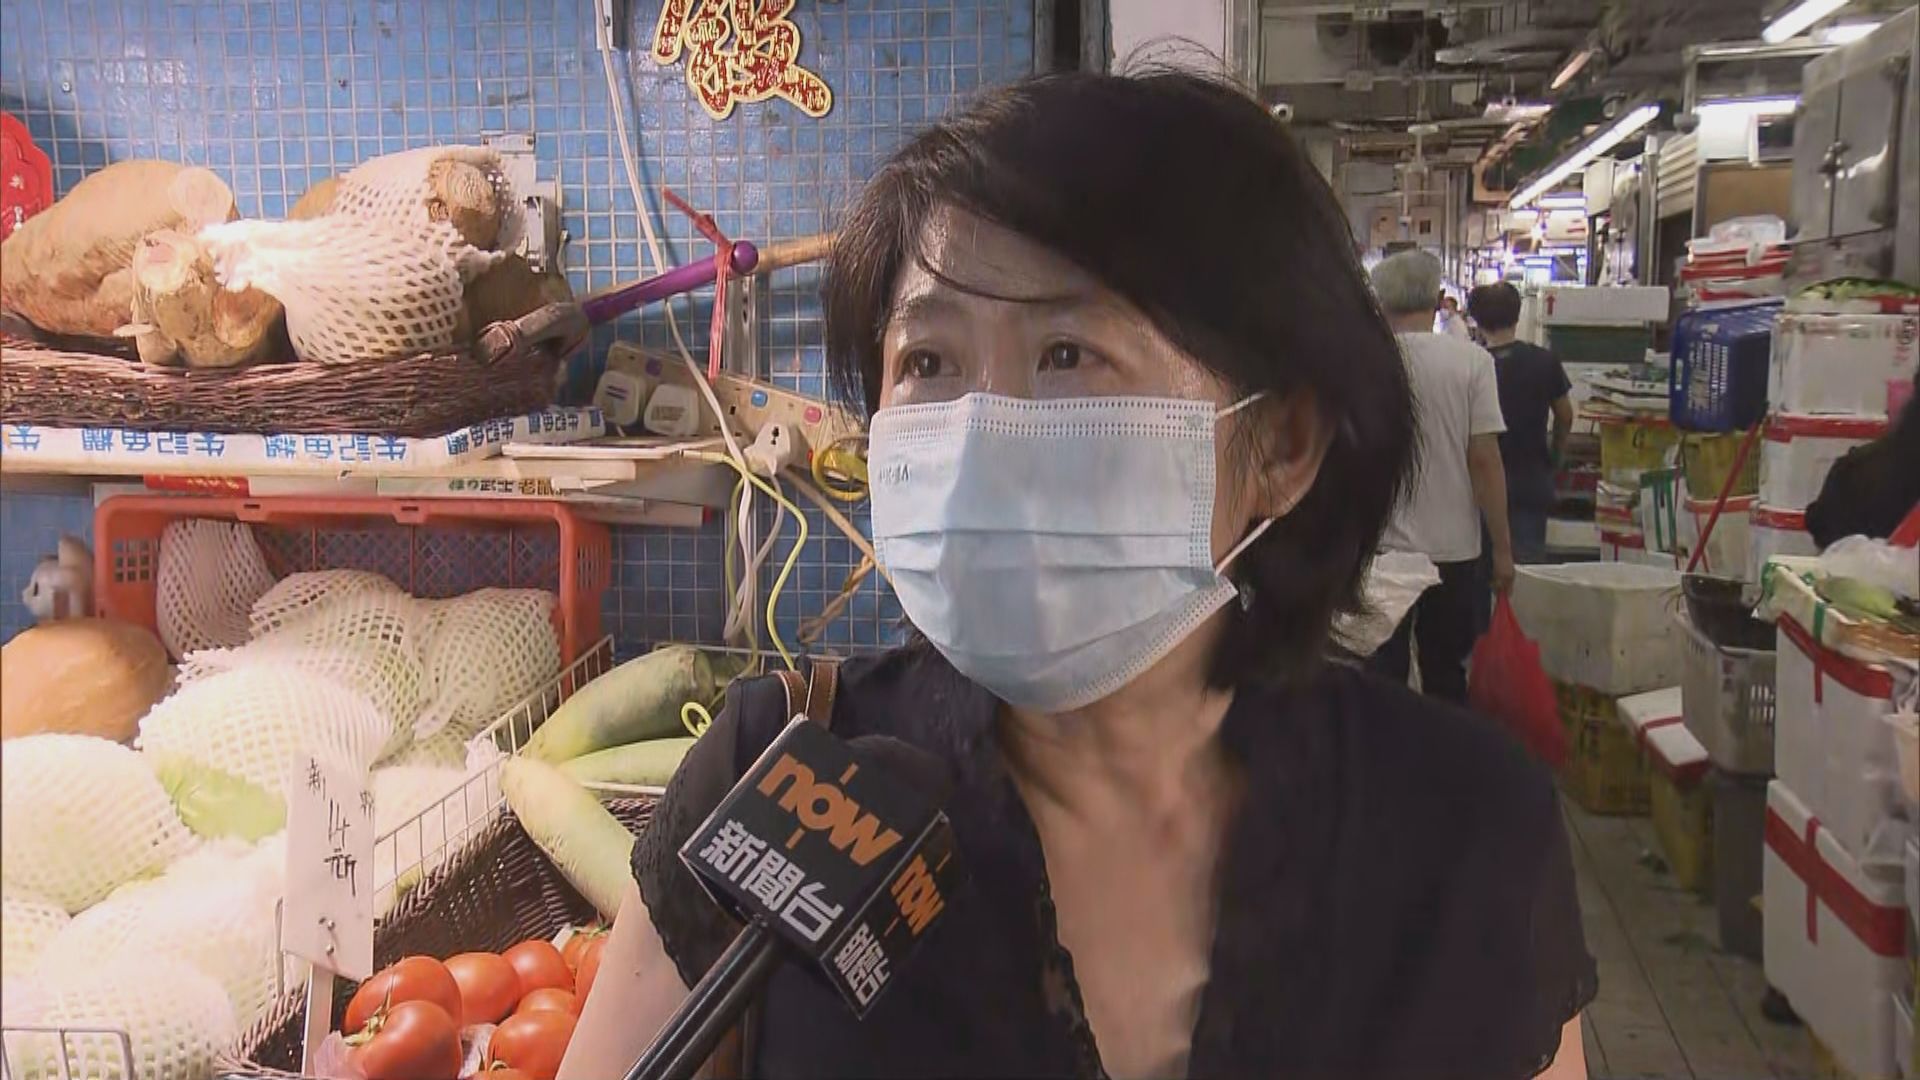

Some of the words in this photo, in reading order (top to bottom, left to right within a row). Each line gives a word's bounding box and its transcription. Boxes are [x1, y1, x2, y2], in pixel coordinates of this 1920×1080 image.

[757, 752, 903, 866] now
[699, 819, 844, 942] 新聞台
[890, 853, 945, 936] now
[834, 923, 891, 1006] 新聞台
